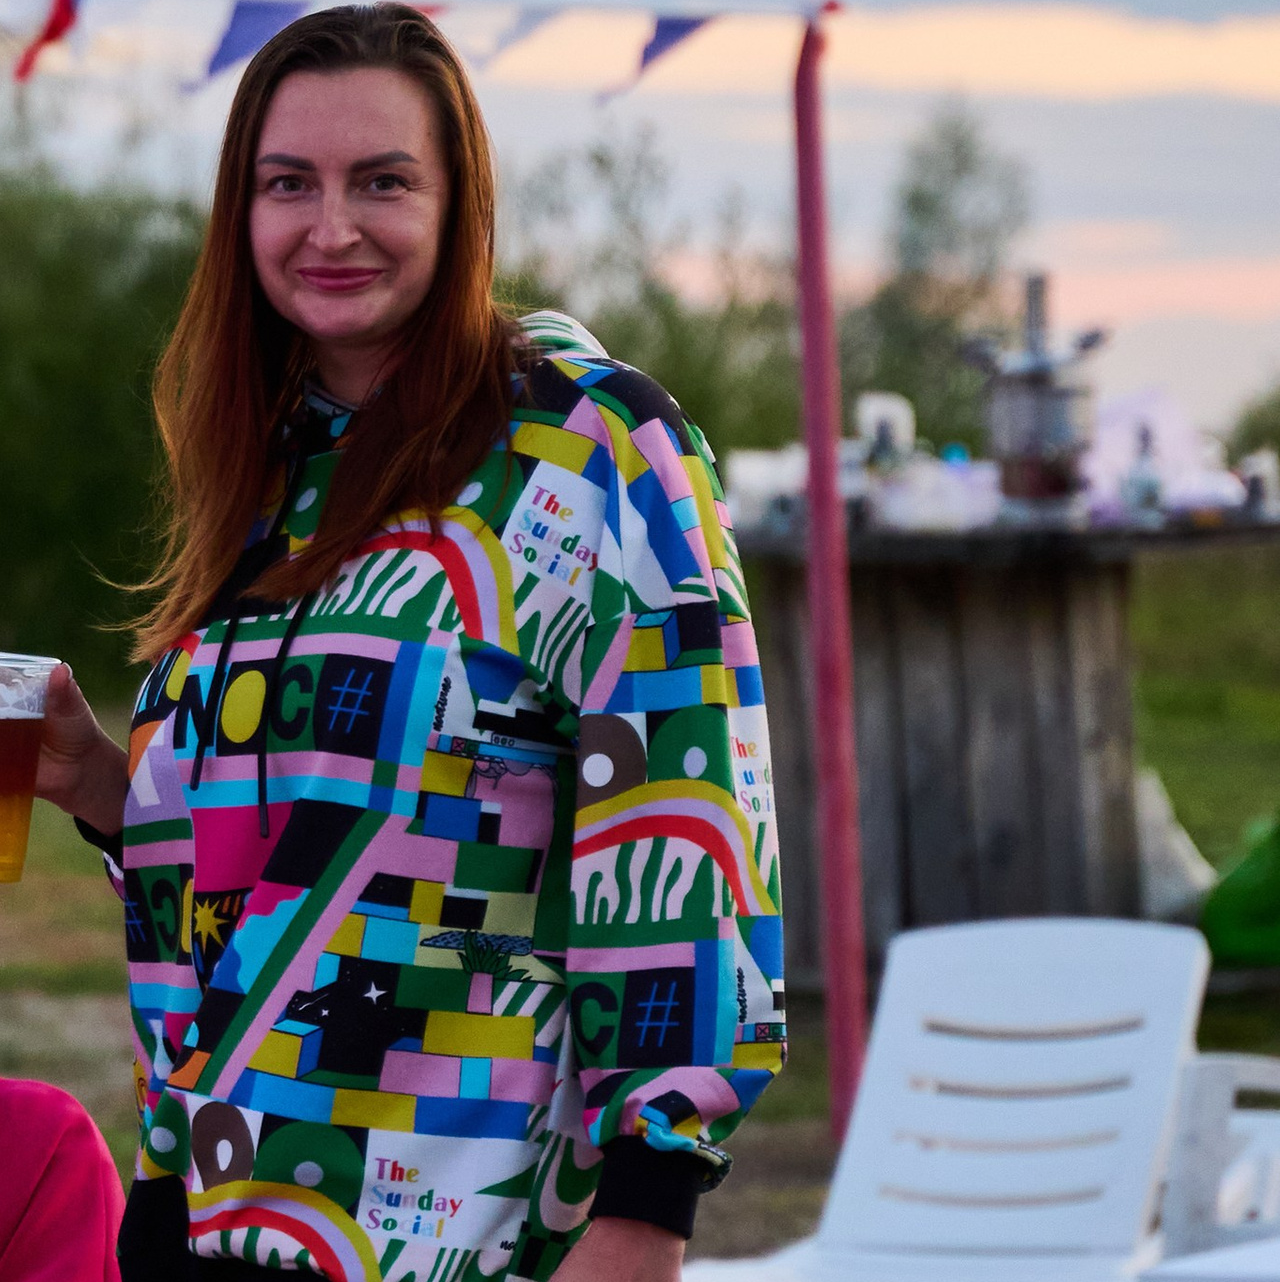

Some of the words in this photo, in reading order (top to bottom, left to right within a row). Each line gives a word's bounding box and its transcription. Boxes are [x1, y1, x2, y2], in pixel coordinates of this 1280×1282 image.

[531, 485, 574, 523] The
[518, 508, 599, 573] Sunday
[509, 532, 583, 587] Social
[375, 1157, 420, 1183] The
[369, 1184, 463, 1218] Sunday
[365, 1208, 446, 1239] Social
